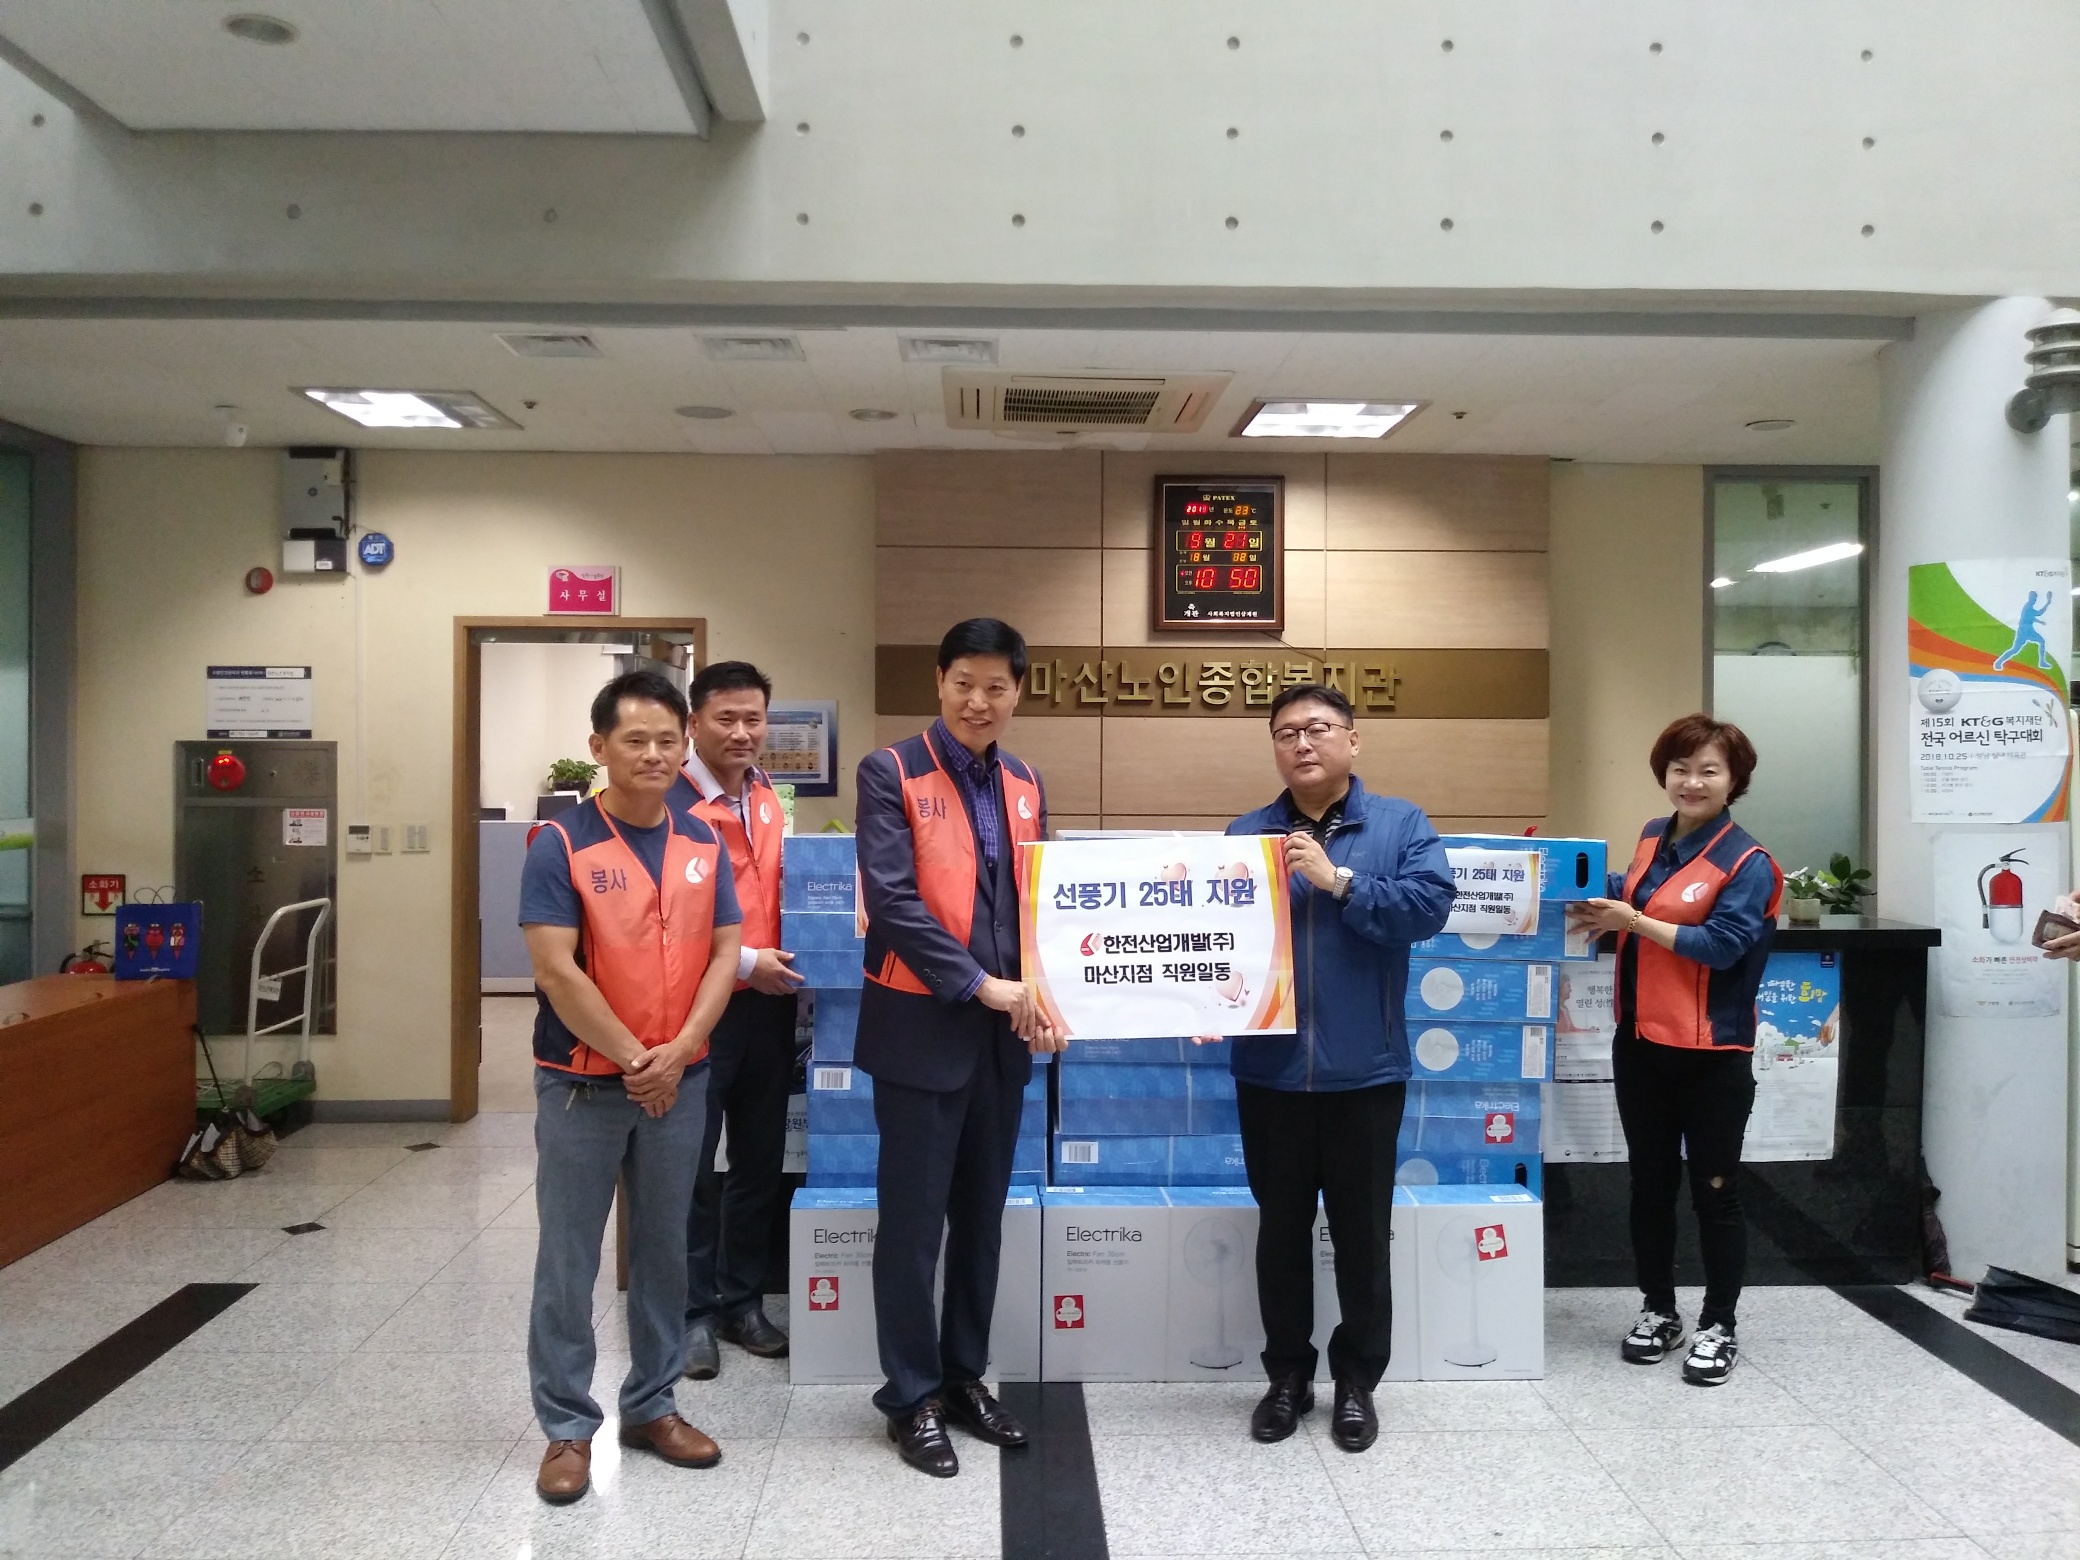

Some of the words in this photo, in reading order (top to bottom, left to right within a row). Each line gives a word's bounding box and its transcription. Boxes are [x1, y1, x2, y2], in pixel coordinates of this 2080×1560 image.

[1204, 538, 1216, 548] 월
[1224, 532, 1247, 548] 21
[1248, 538, 1259, 548] 일
[364, 543, 386, 555] ADT
[1195, 568, 1215, 588] 10
[1230, 568, 1258, 588] 50
[1920, 718, 1954, 728] 제15회
[1961, 716, 2004, 728] KT&G
[2006, 716, 2042, 726] 복지재단
[1920, 731, 1946, 747] 전국
[1949, 730, 1990, 746] 어르신
[1994, 729, 2043, 746] 탁구대회
[1920, 752, 1968, 760] 2018.10.25
[917, 797, 947, 819] 봉사
[591, 868, 627, 894] 봉사
[1502, 869, 1525, 882] 지원
[89, 880, 119, 888] 소화기
[808, 882, 852, 892] Electrika
[1053, 881, 1127, 910] 선풍기
[1139, 880, 1193, 907] 25대
[1206, 878, 1256, 905] 지원
[1480, 904, 1511, 914] 직원일동
[1103, 932, 1234, 954] 한전산업개발(주)
[1084, 964, 1153, 984] 마산지점
[1162, 962, 1231, 982] 직원일동
[1588, 985, 1614, 995] 행복한
[1576, 998, 1592, 1008] 열린
[1475, 1101, 1520, 1112] Electrika
[1066, 1226, 1142, 1242] Electrika
